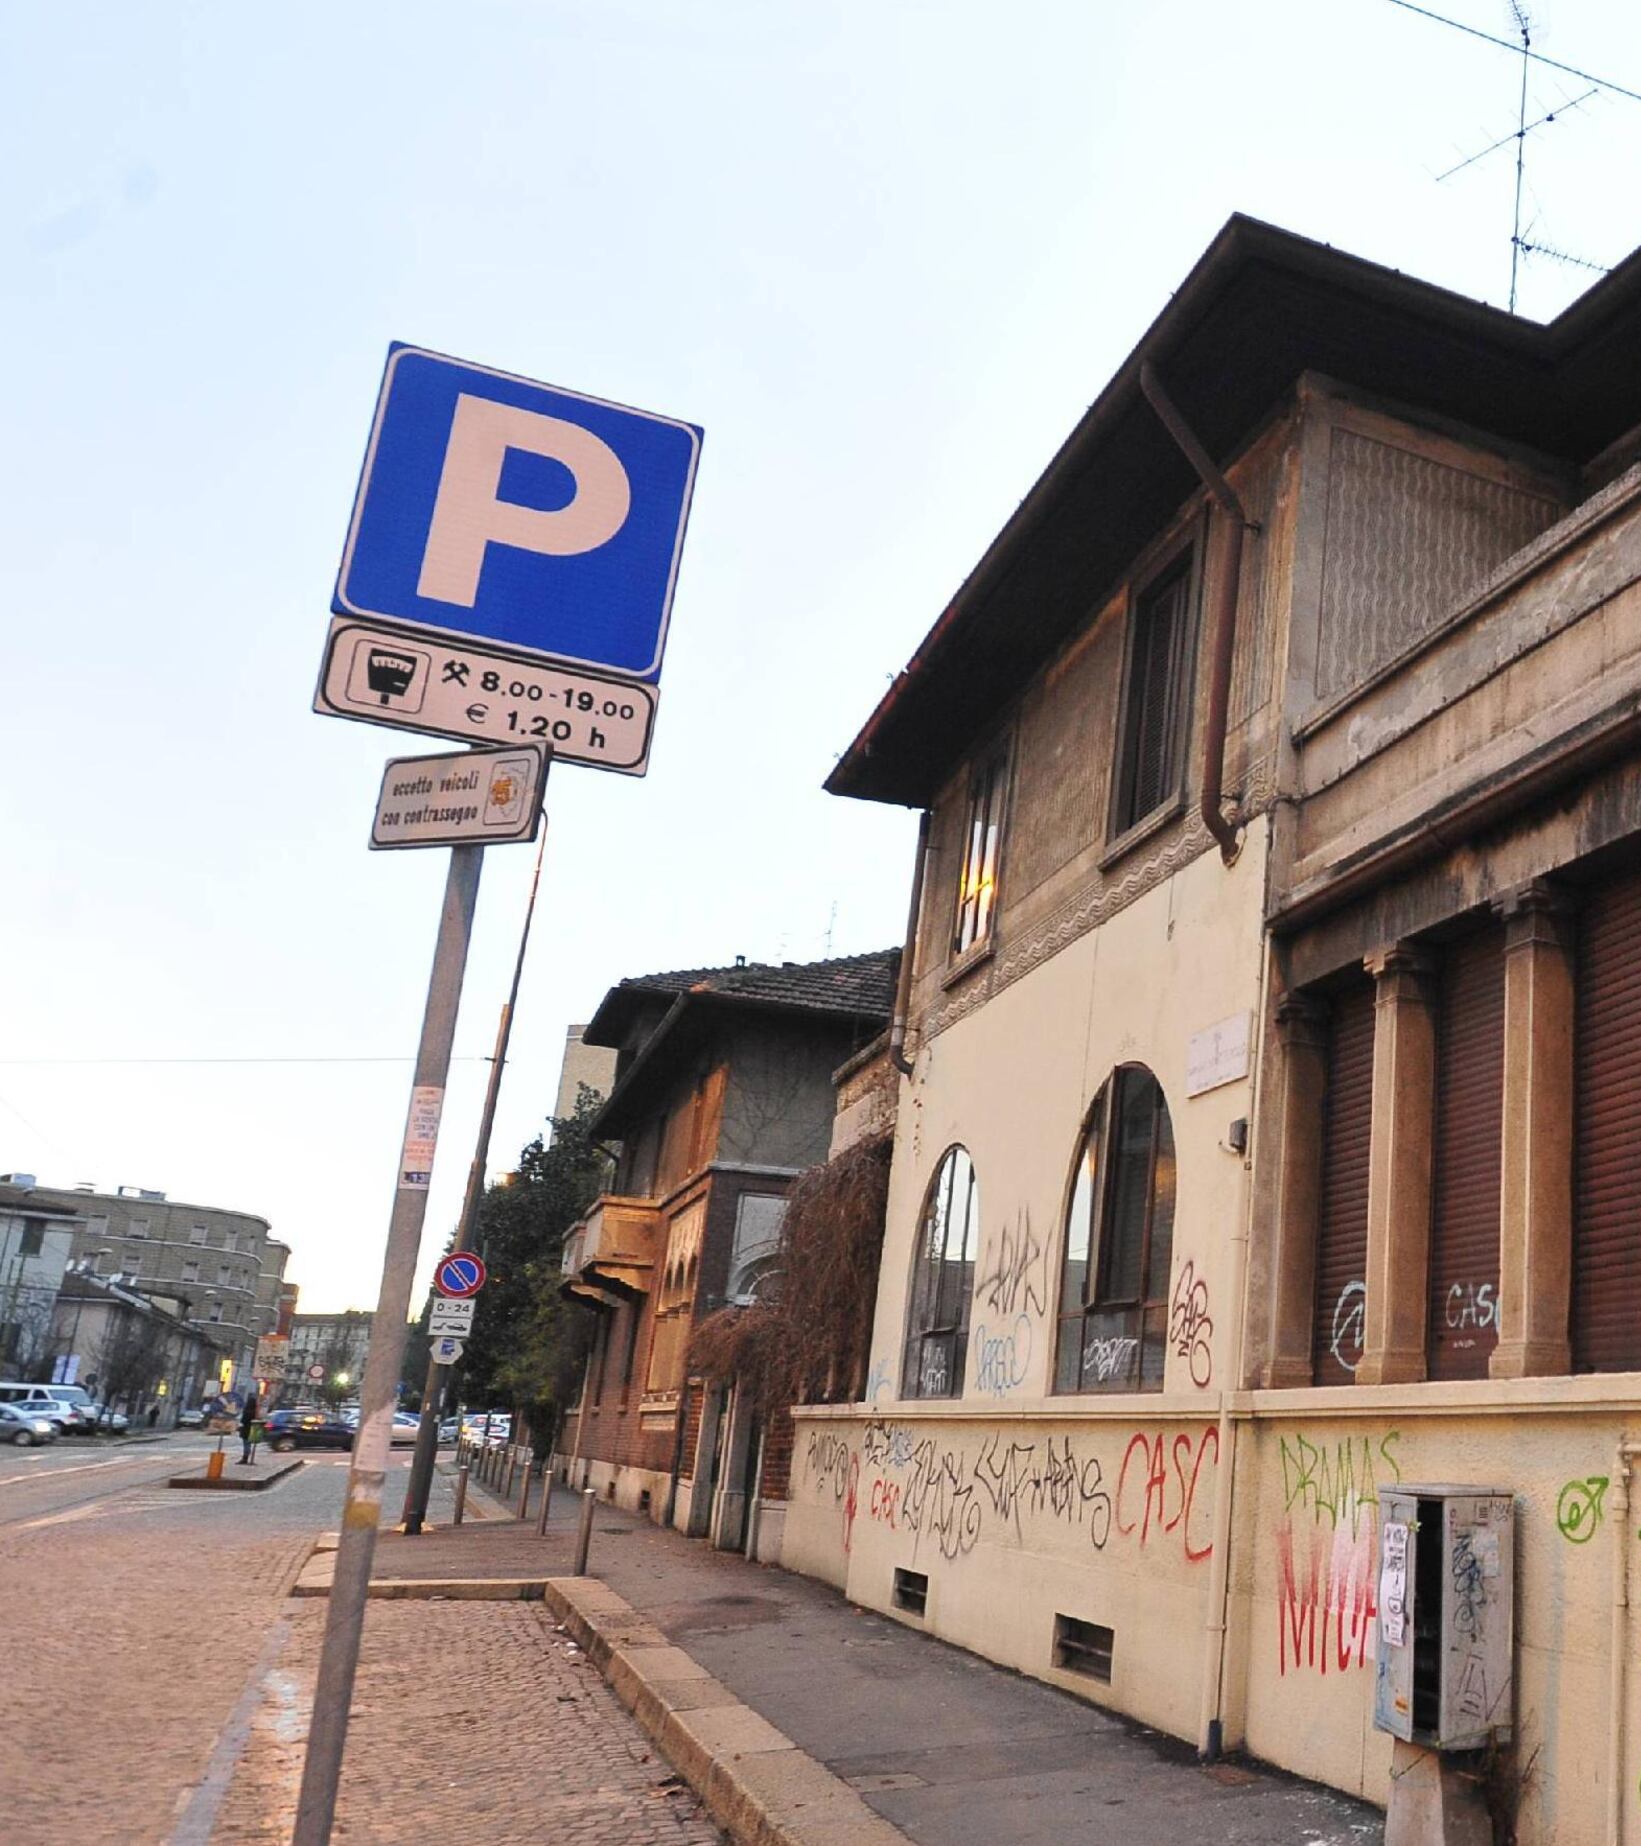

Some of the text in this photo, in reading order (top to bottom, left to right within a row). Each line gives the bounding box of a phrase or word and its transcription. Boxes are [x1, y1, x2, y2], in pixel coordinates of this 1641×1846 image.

[416, 392, 631, 608] P
[466, 703, 605, 748] € 1.20 h
[392, 771, 480, 797] eccetto veicoli
[381, 805, 478, 826] con contrassegno
[1115, 1425, 1219, 1562] CASC
